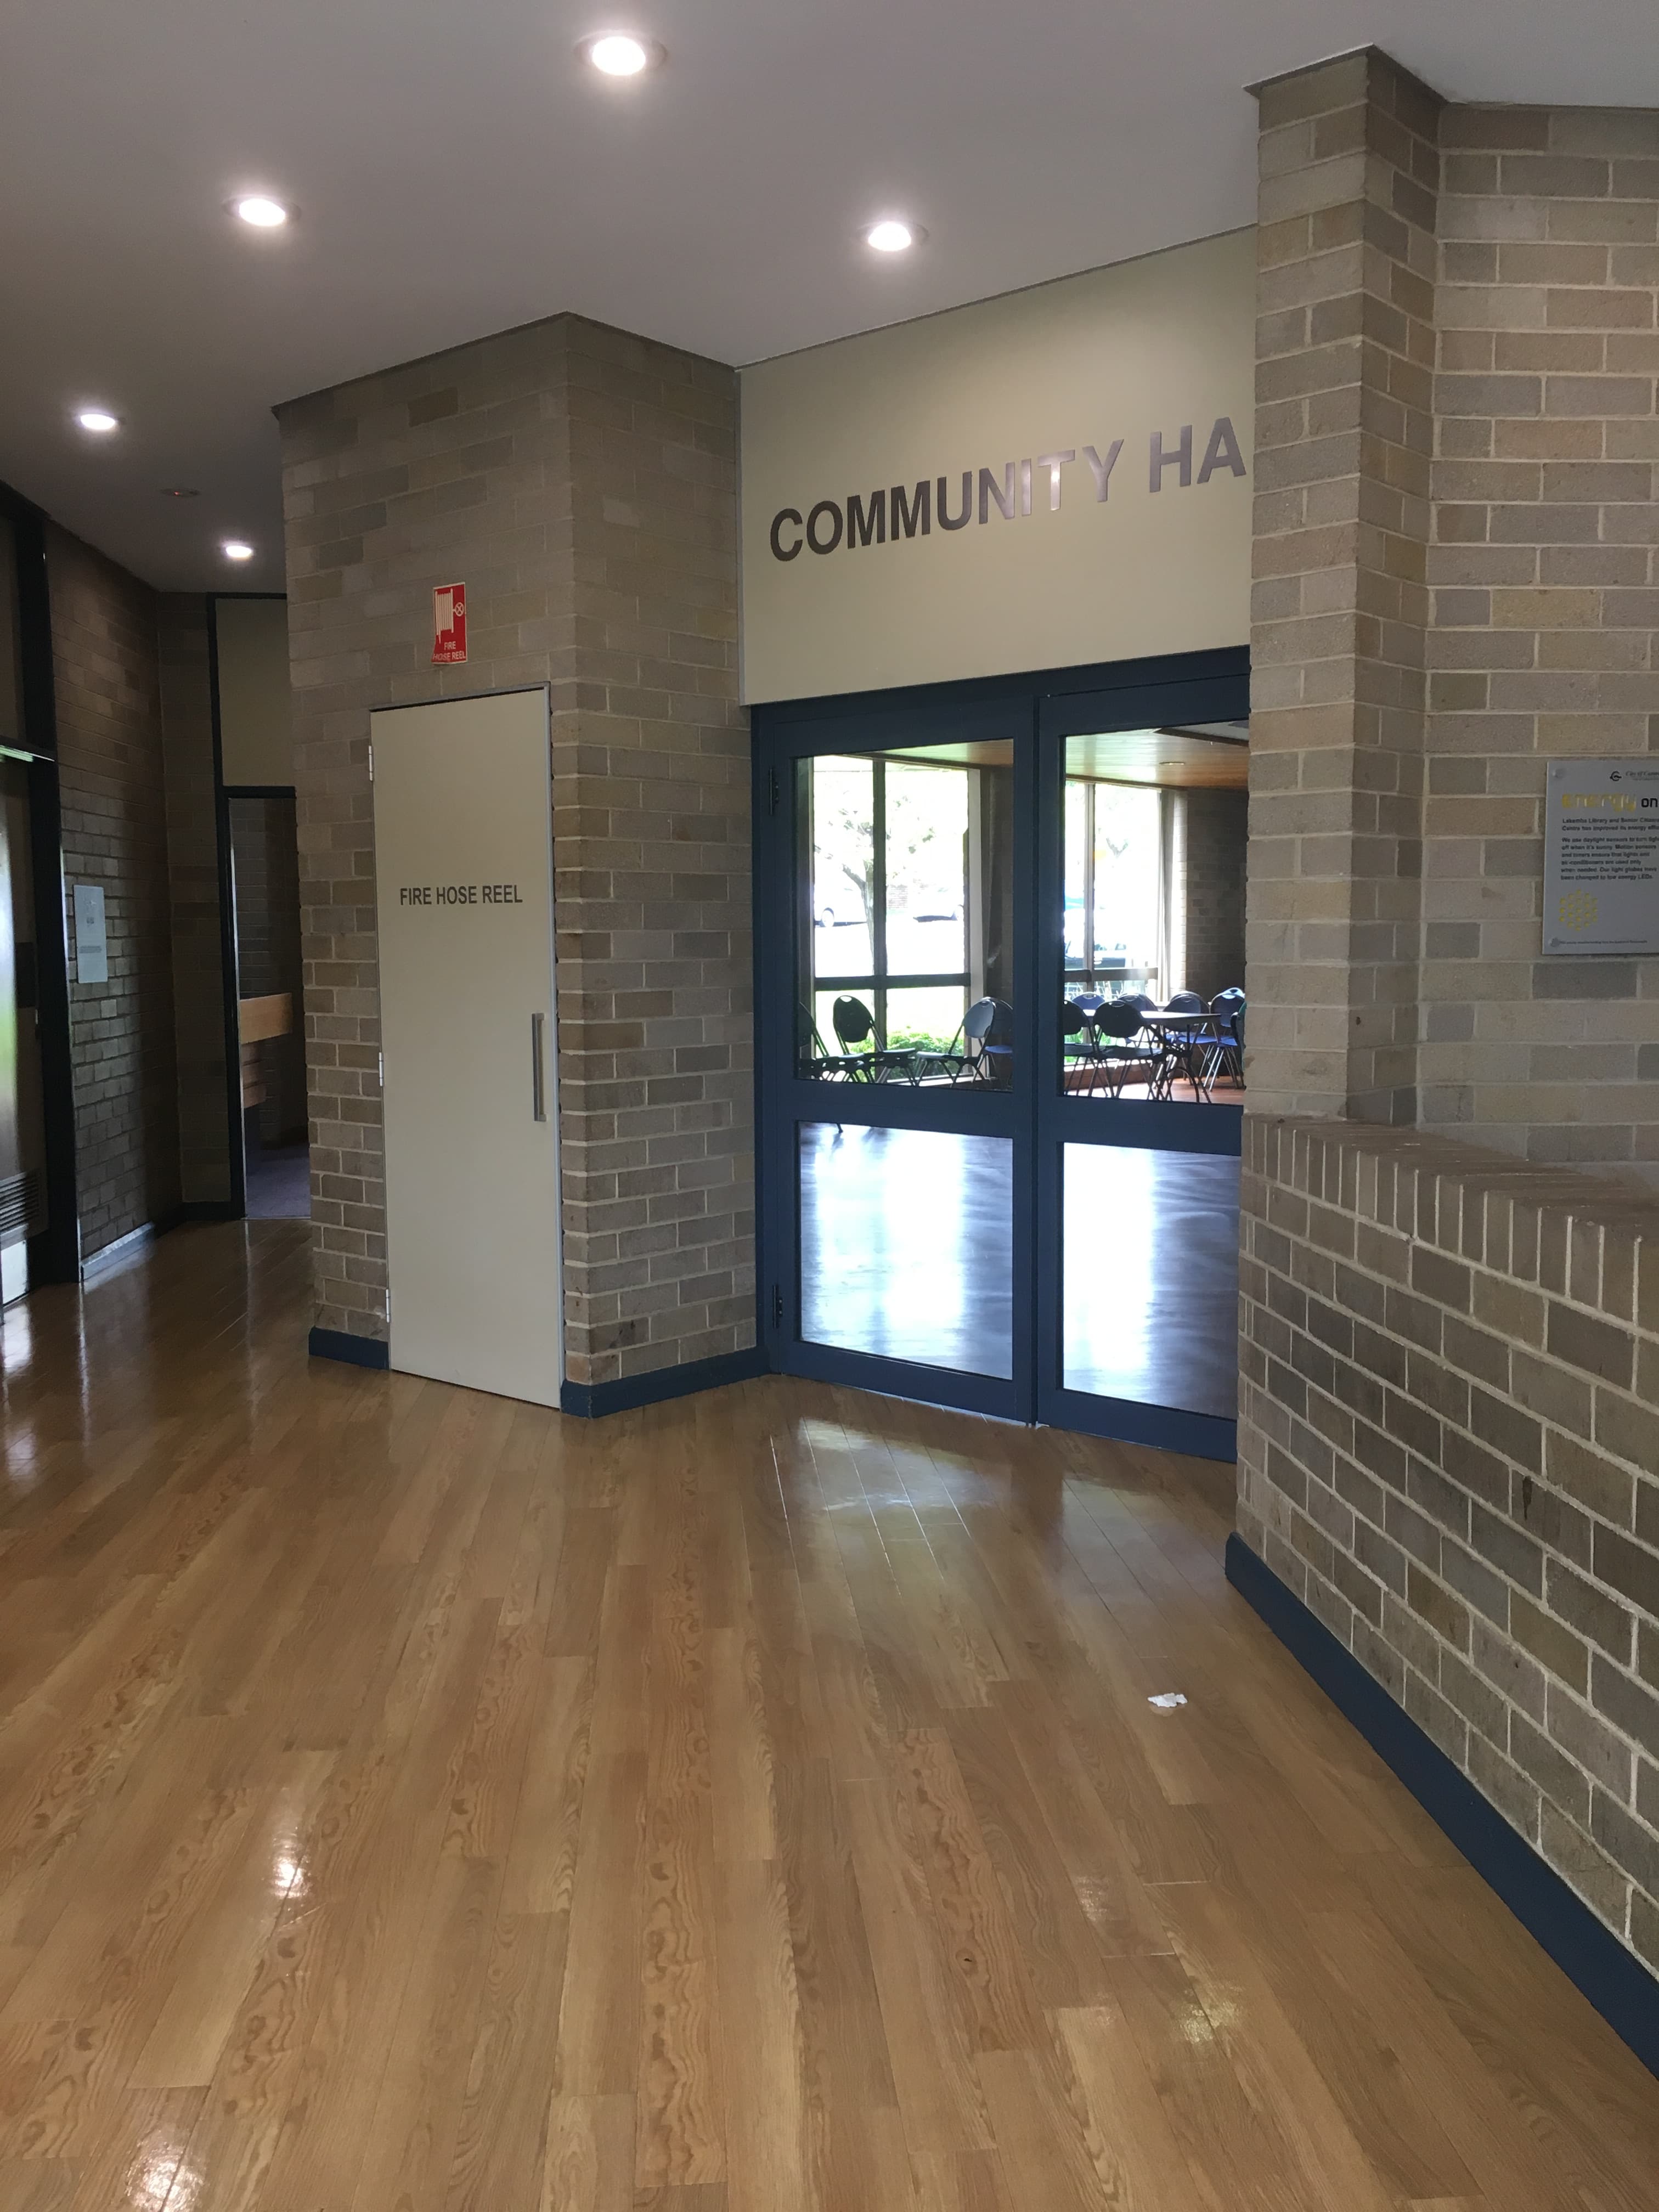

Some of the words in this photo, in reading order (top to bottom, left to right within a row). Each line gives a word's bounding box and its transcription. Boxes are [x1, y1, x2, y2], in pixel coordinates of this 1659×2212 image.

[770, 439, 1124, 562] COMMUNITY
[444, 641, 456, 650] FIRE
[433, 652, 450, 661] HOSE
[452, 651, 466, 659] REEL
[400, 887, 432, 905] FIRE
[437, 886, 477, 904] HOSE
[482, 885, 523, 904] REEL
